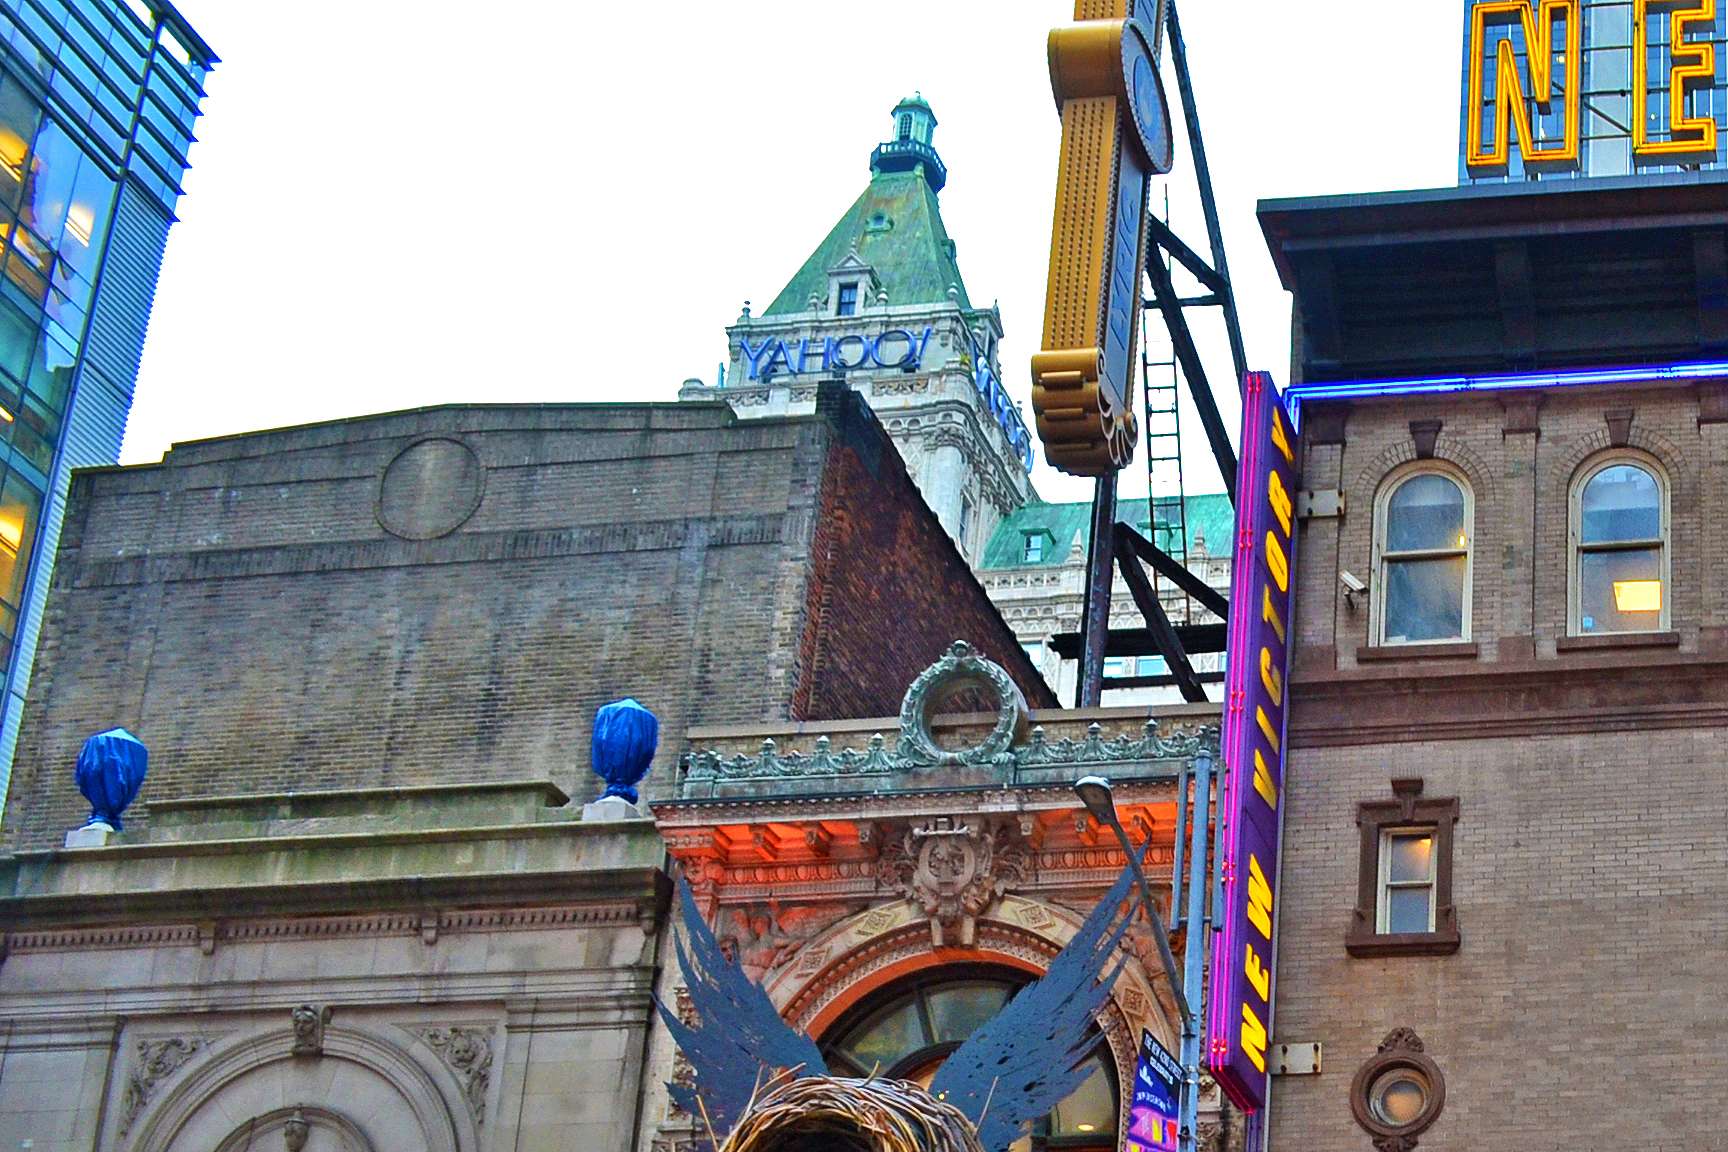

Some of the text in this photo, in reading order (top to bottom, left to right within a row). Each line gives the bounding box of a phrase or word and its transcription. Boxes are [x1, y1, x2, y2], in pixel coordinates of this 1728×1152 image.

[740, 325, 933, 380] YAHOO!
[1240, 405, 1294, 1073] NEW VICTORY
